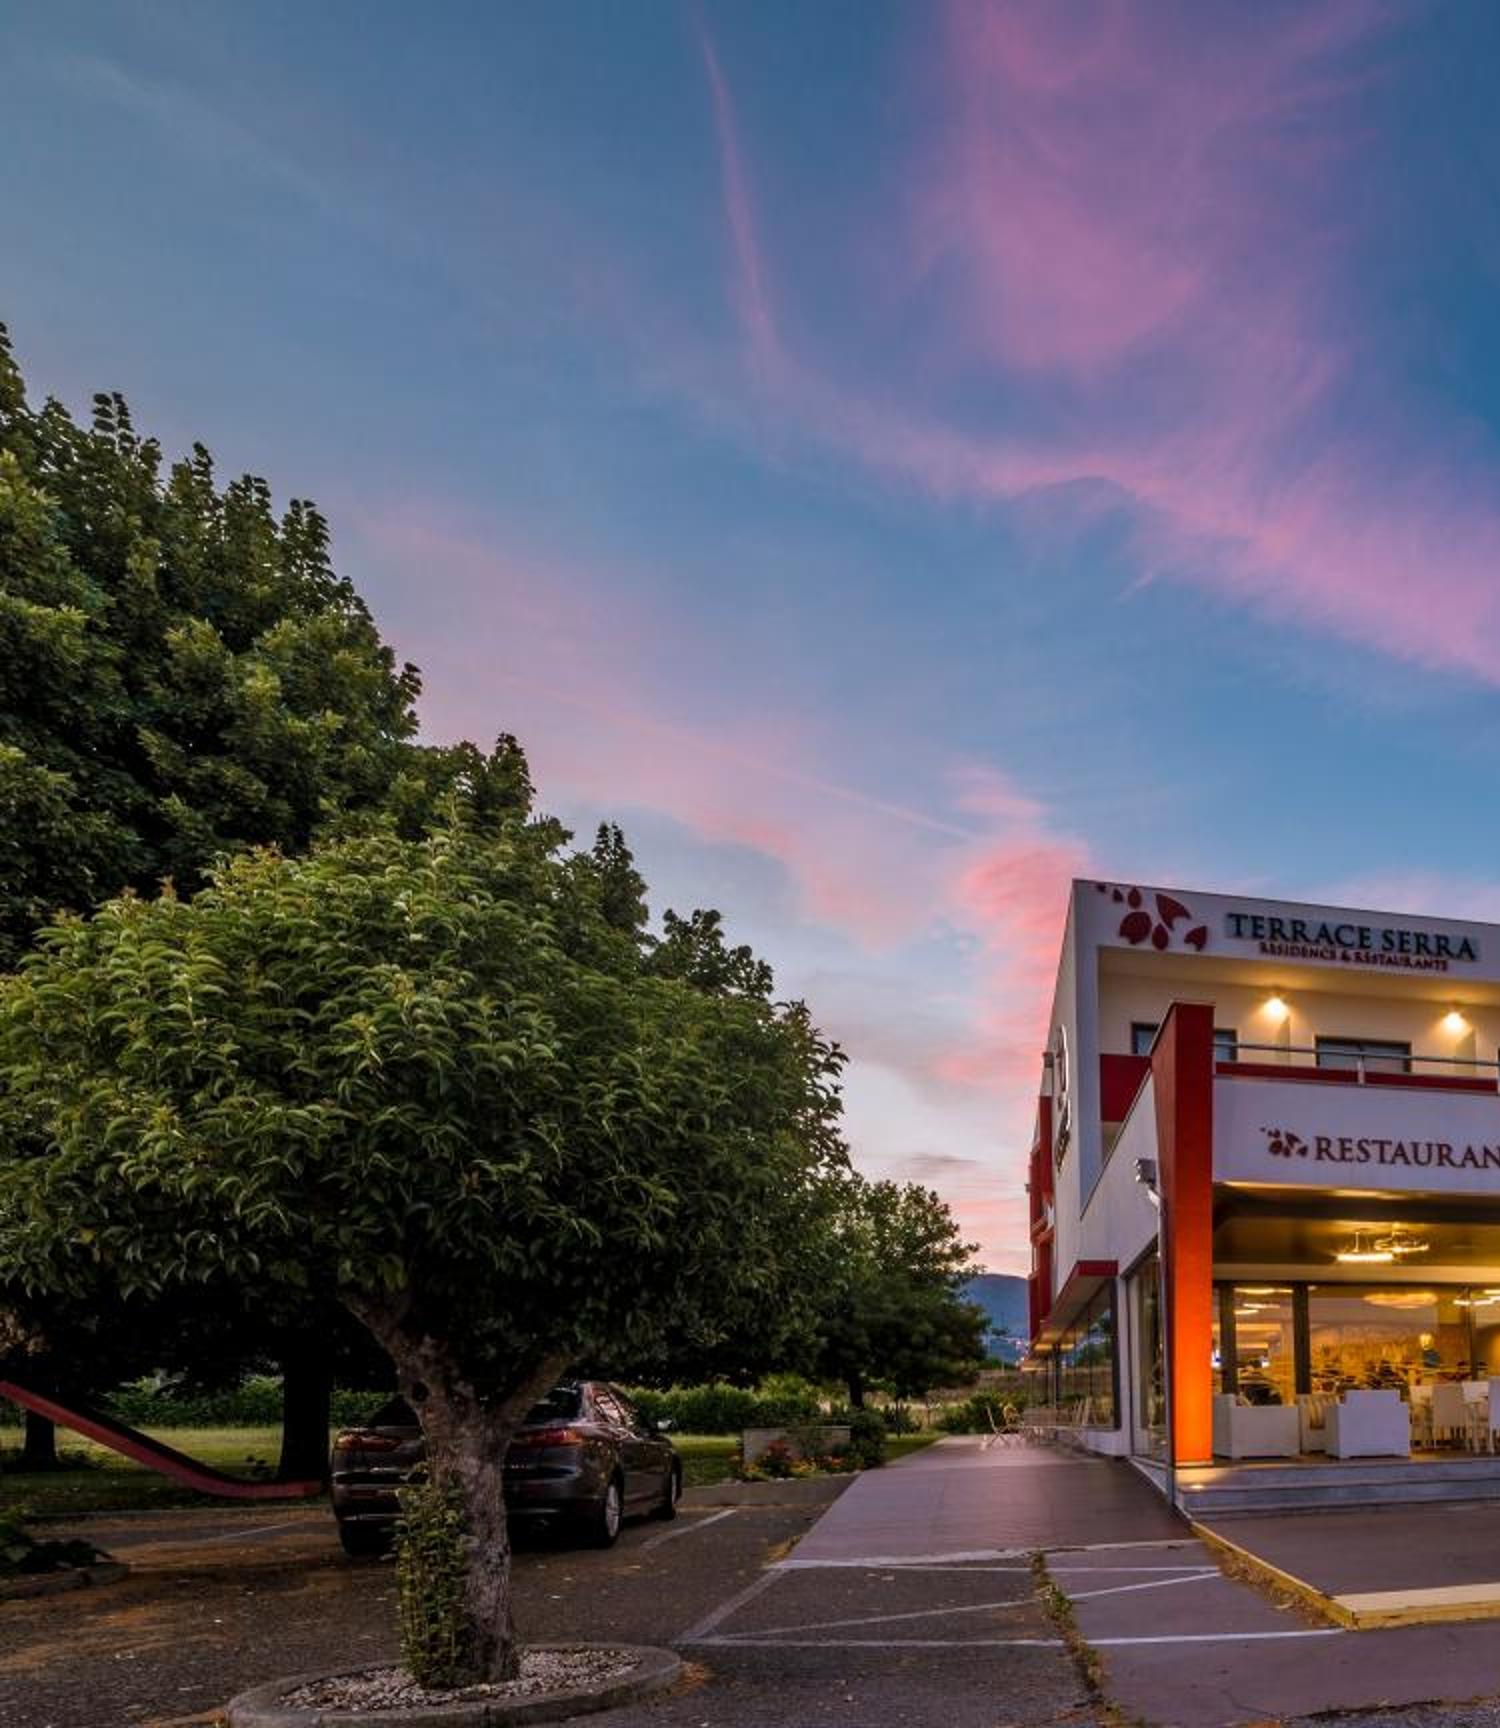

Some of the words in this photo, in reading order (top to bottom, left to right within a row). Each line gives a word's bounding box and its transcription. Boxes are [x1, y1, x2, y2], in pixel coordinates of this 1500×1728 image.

[1227, 913, 1372, 949] TERRACE
[1381, 928, 1477, 961] SERRA
[1259, 942, 1337, 961] RESIDENCE
[1341, 951, 1351, 962] &
[1354, 951, 1449, 972] RESTAURANTE
